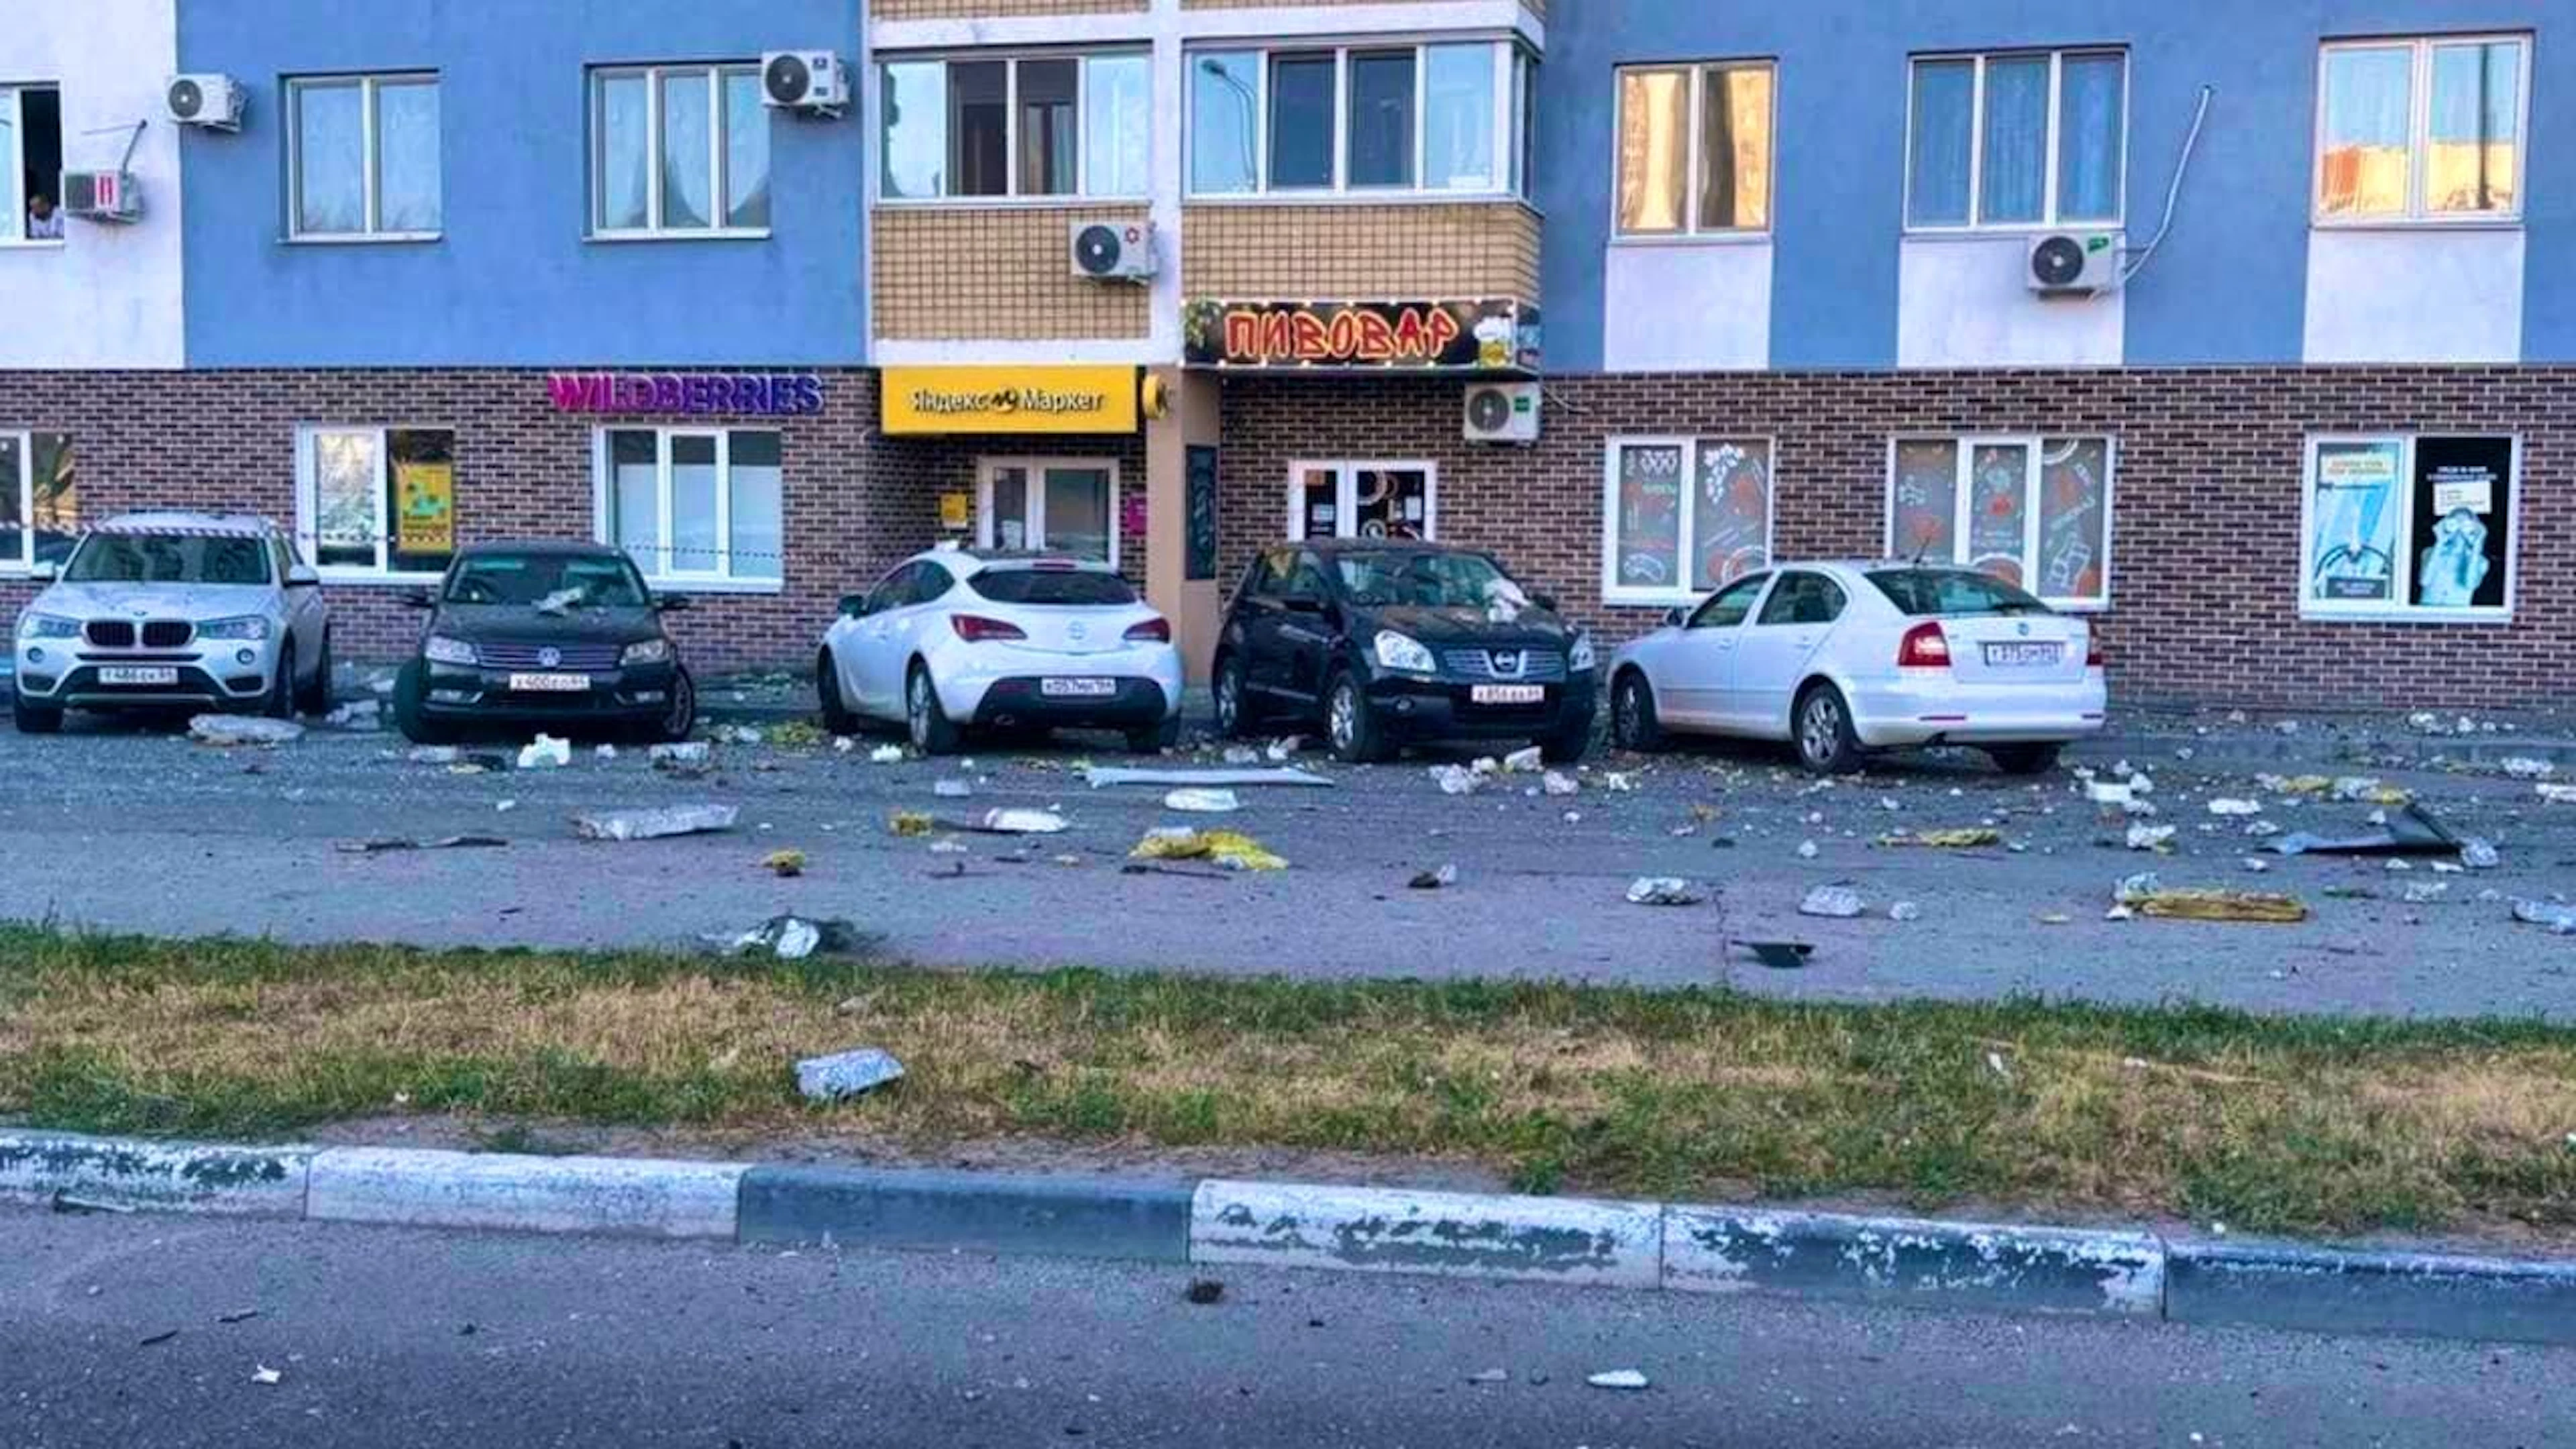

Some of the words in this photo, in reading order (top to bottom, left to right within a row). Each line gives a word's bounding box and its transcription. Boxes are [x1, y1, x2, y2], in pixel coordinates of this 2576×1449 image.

[1222, 308, 1459, 360] ПИВОВАР
[547, 372, 825, 413] WILDBERRIES
[914, 388, 989, 413] Яндекс
[1023, 388, 1105, 414] Маркет
